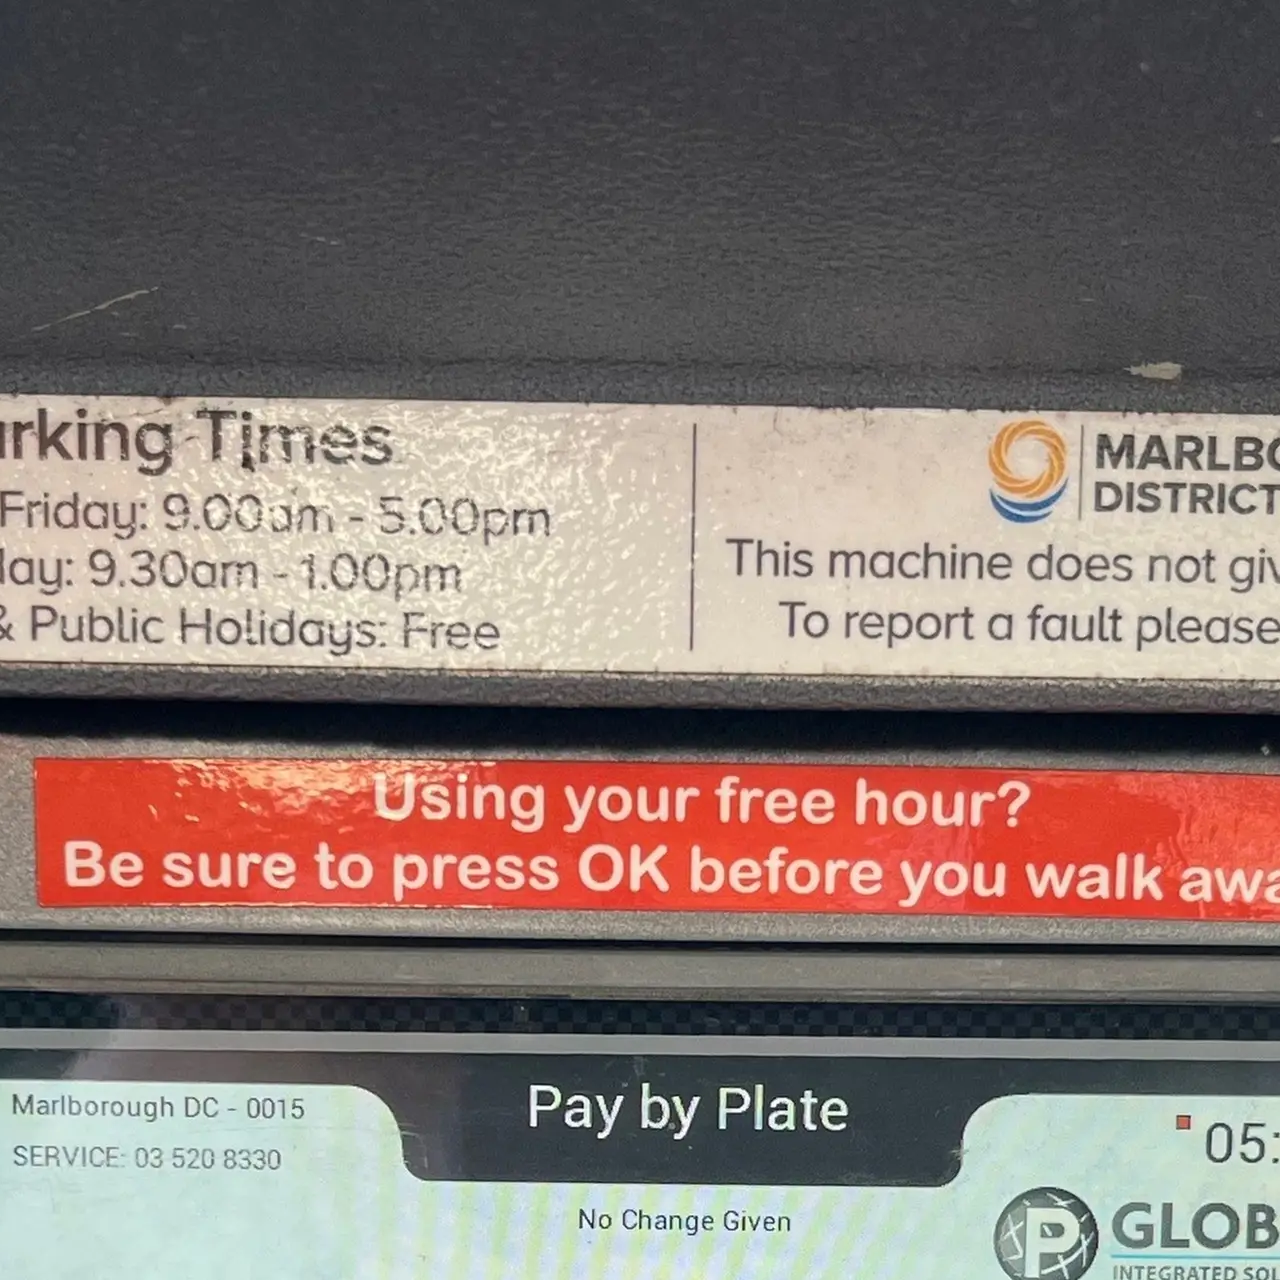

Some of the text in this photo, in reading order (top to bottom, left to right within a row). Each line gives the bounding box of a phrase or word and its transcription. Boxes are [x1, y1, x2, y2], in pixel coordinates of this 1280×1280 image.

[196, 409, 394, 467] Times
[0, 490, 148, 540] Friday:
[163, 494, 333, 533] 9.00am
[378, 497, 551, 544] 5.00pm
[89, 550, 258, 589] 9.30am
[301, 553, 461, 600] 1.00pm
[726, 540, 813, 579] This
[829, 543, 1012, 581] machine
[1027, 545, 1133, 583] does
[1149, 550, 1215, 584] not
[31, 605, 164, 644] Public
[180, 607, 386, 657] Holidays:
[403, 612, 501, 651] Free
[780, 601, 829, 639] To
[845, 606, 974, 648] report
[989, 612, 1013, 641] a
[1028, 604, 1123, 643] fault
[374, 773, 1030, 834] Using your free hour?
[64, 841, 143, 888] Be
[163, 852, 296, 889] sure
[315, 842, 373, 891] to
[393, 852, 559, 901] press
[578, 845, 670, 892] OK
[691, 847, 883, 895] before
[899, 861, 1006, 907] you
[1026, 854, 1163, 901] walk
[12, 1094, 174, 1122] Marlborough
[184, 1097, 219, 1118] DC
[247, 1098, 305, 1119] 0015
[529, 1082, 849, 1141] Pay by Plate
[13, 1146, 282, 1171] SERVICE: 03 520 8330
[578, 1209, 792, 1236] No Change Given
